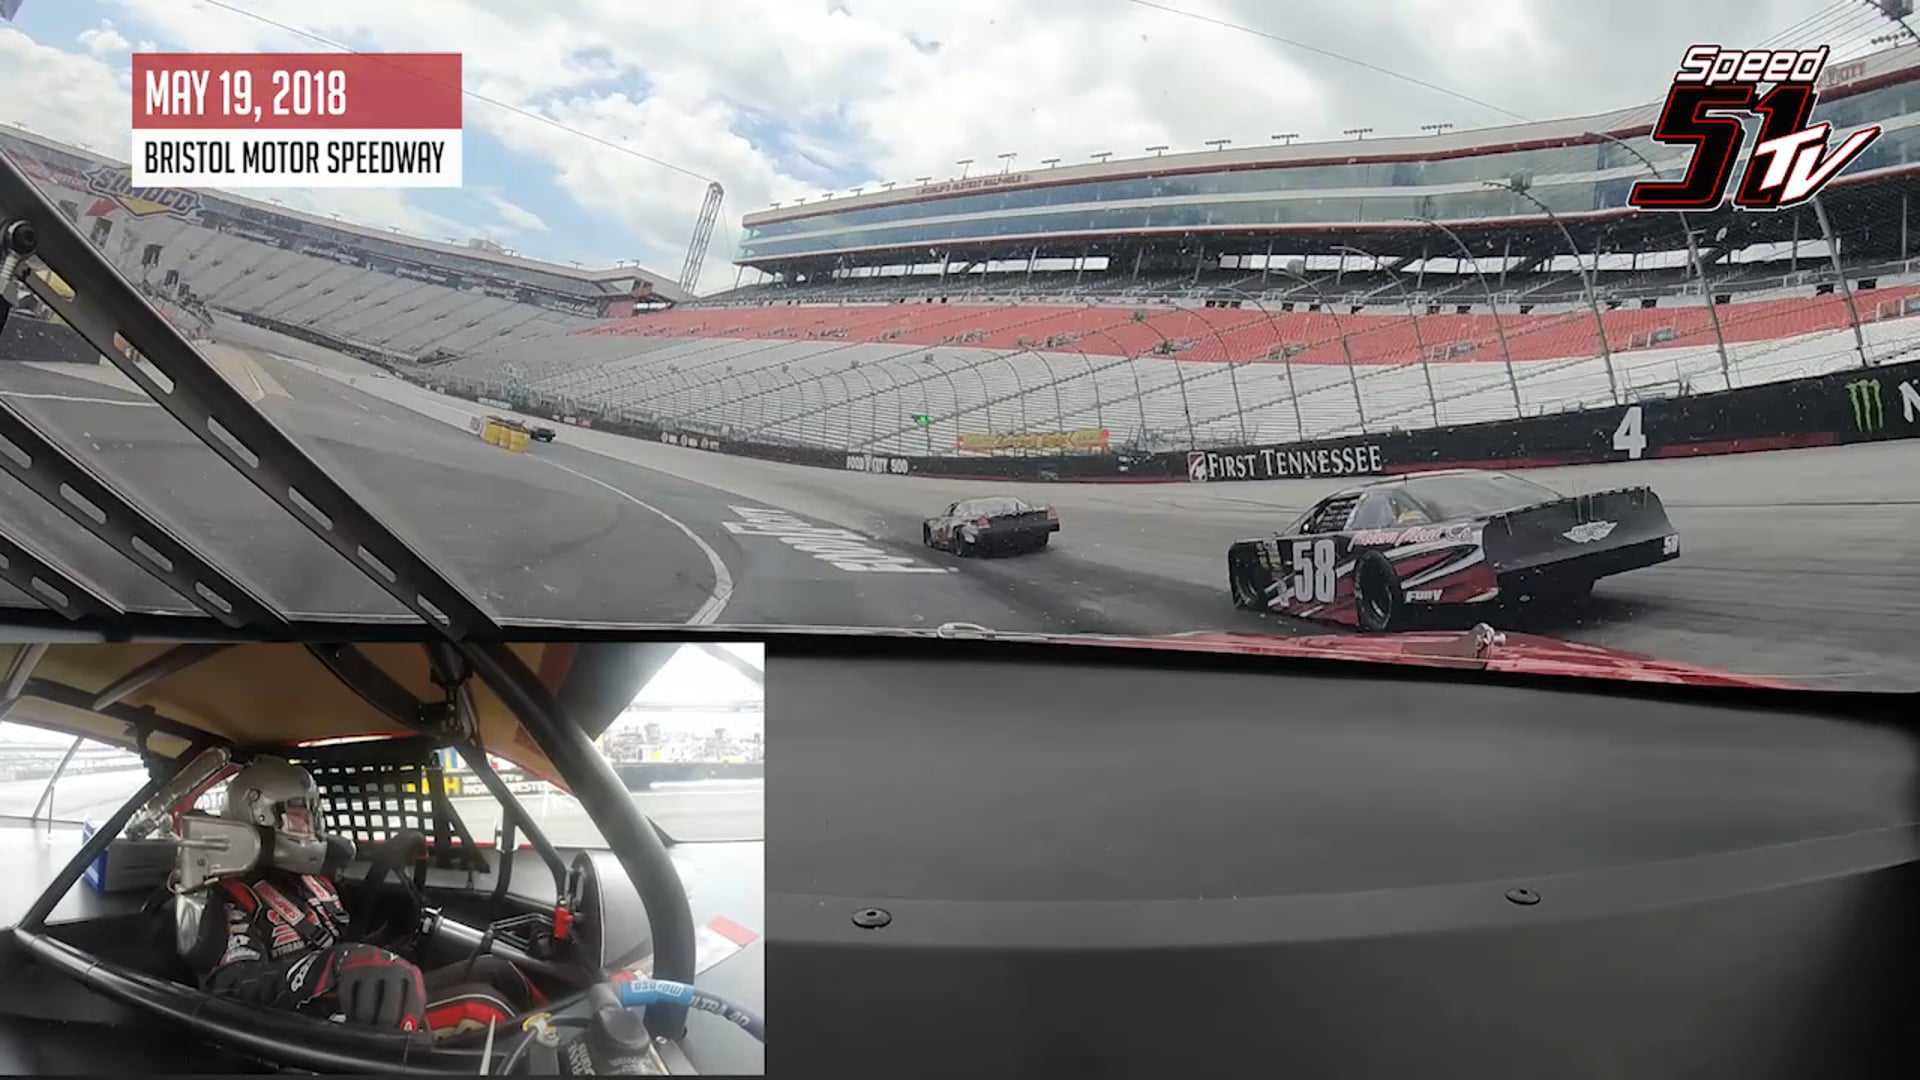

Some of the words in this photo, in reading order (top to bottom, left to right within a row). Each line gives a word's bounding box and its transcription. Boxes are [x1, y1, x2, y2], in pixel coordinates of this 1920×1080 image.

[1612, 405, 1647, 459] 4
[891, 457, 908, 474] 500
[1208, 453, 1256, 478] FIRST
[1261, 445, 1382, 476] TENNESSEE
[1292, 538, 1336, 604] 58
